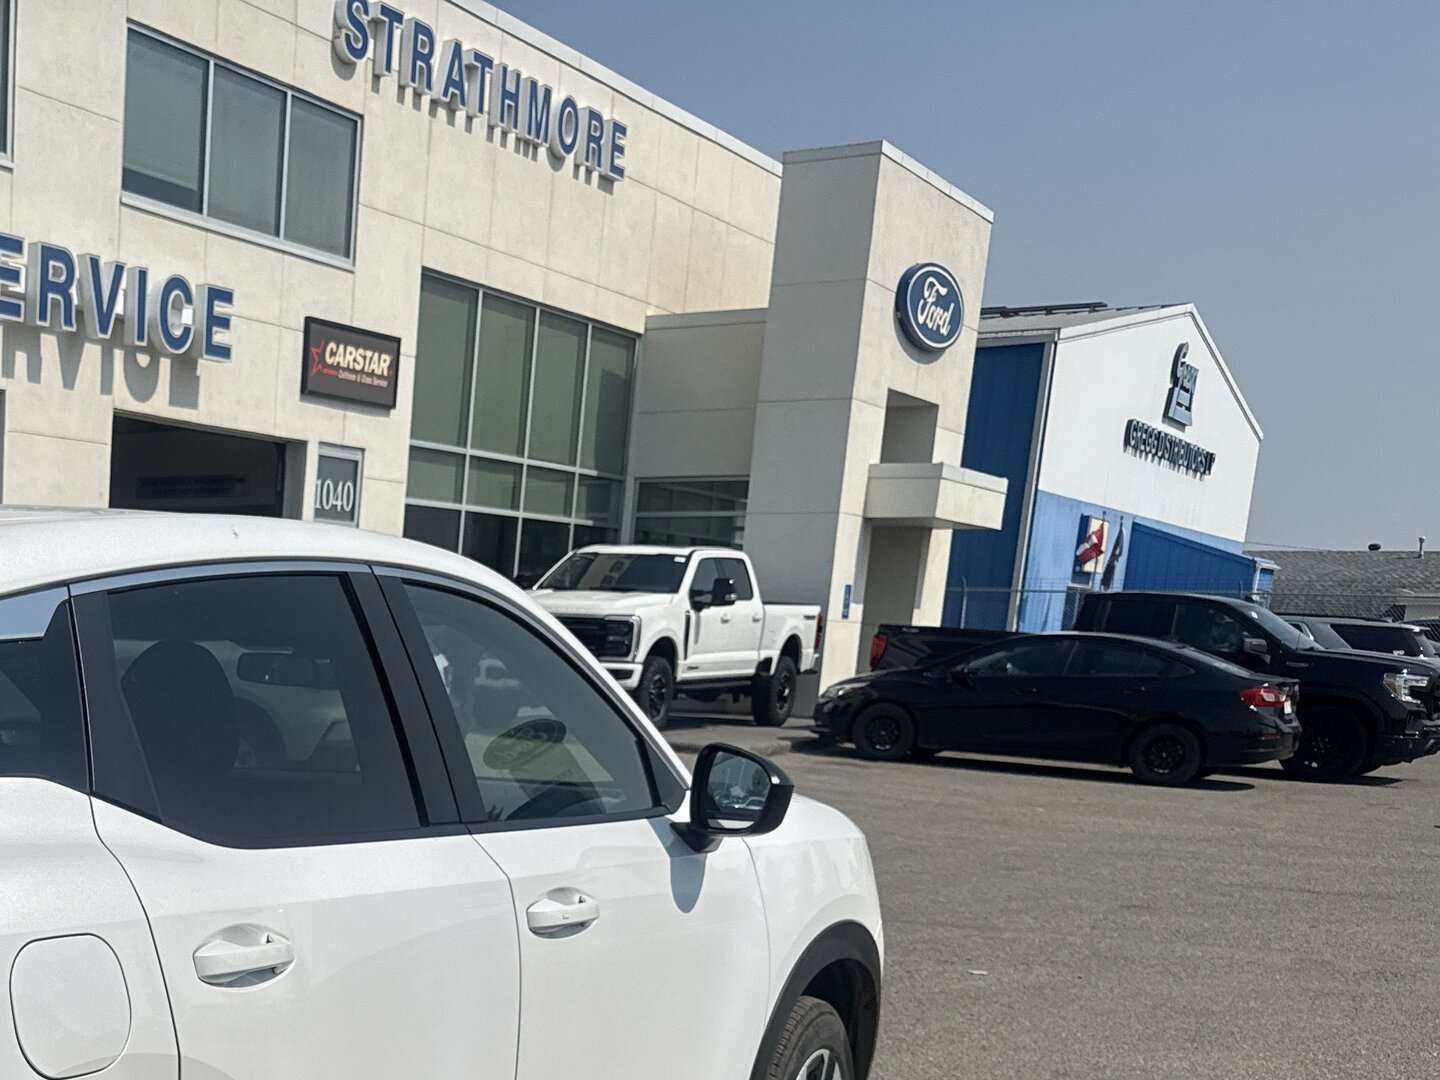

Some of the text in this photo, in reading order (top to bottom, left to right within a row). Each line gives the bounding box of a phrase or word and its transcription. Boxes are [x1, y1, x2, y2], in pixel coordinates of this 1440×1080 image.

[334, 0, 627, 181] STRATHMORE
[917, 276, 955, 337] Ford
[325, 342, 391, 376] CARSTAR
[315, 479, 354, 512] 1040
